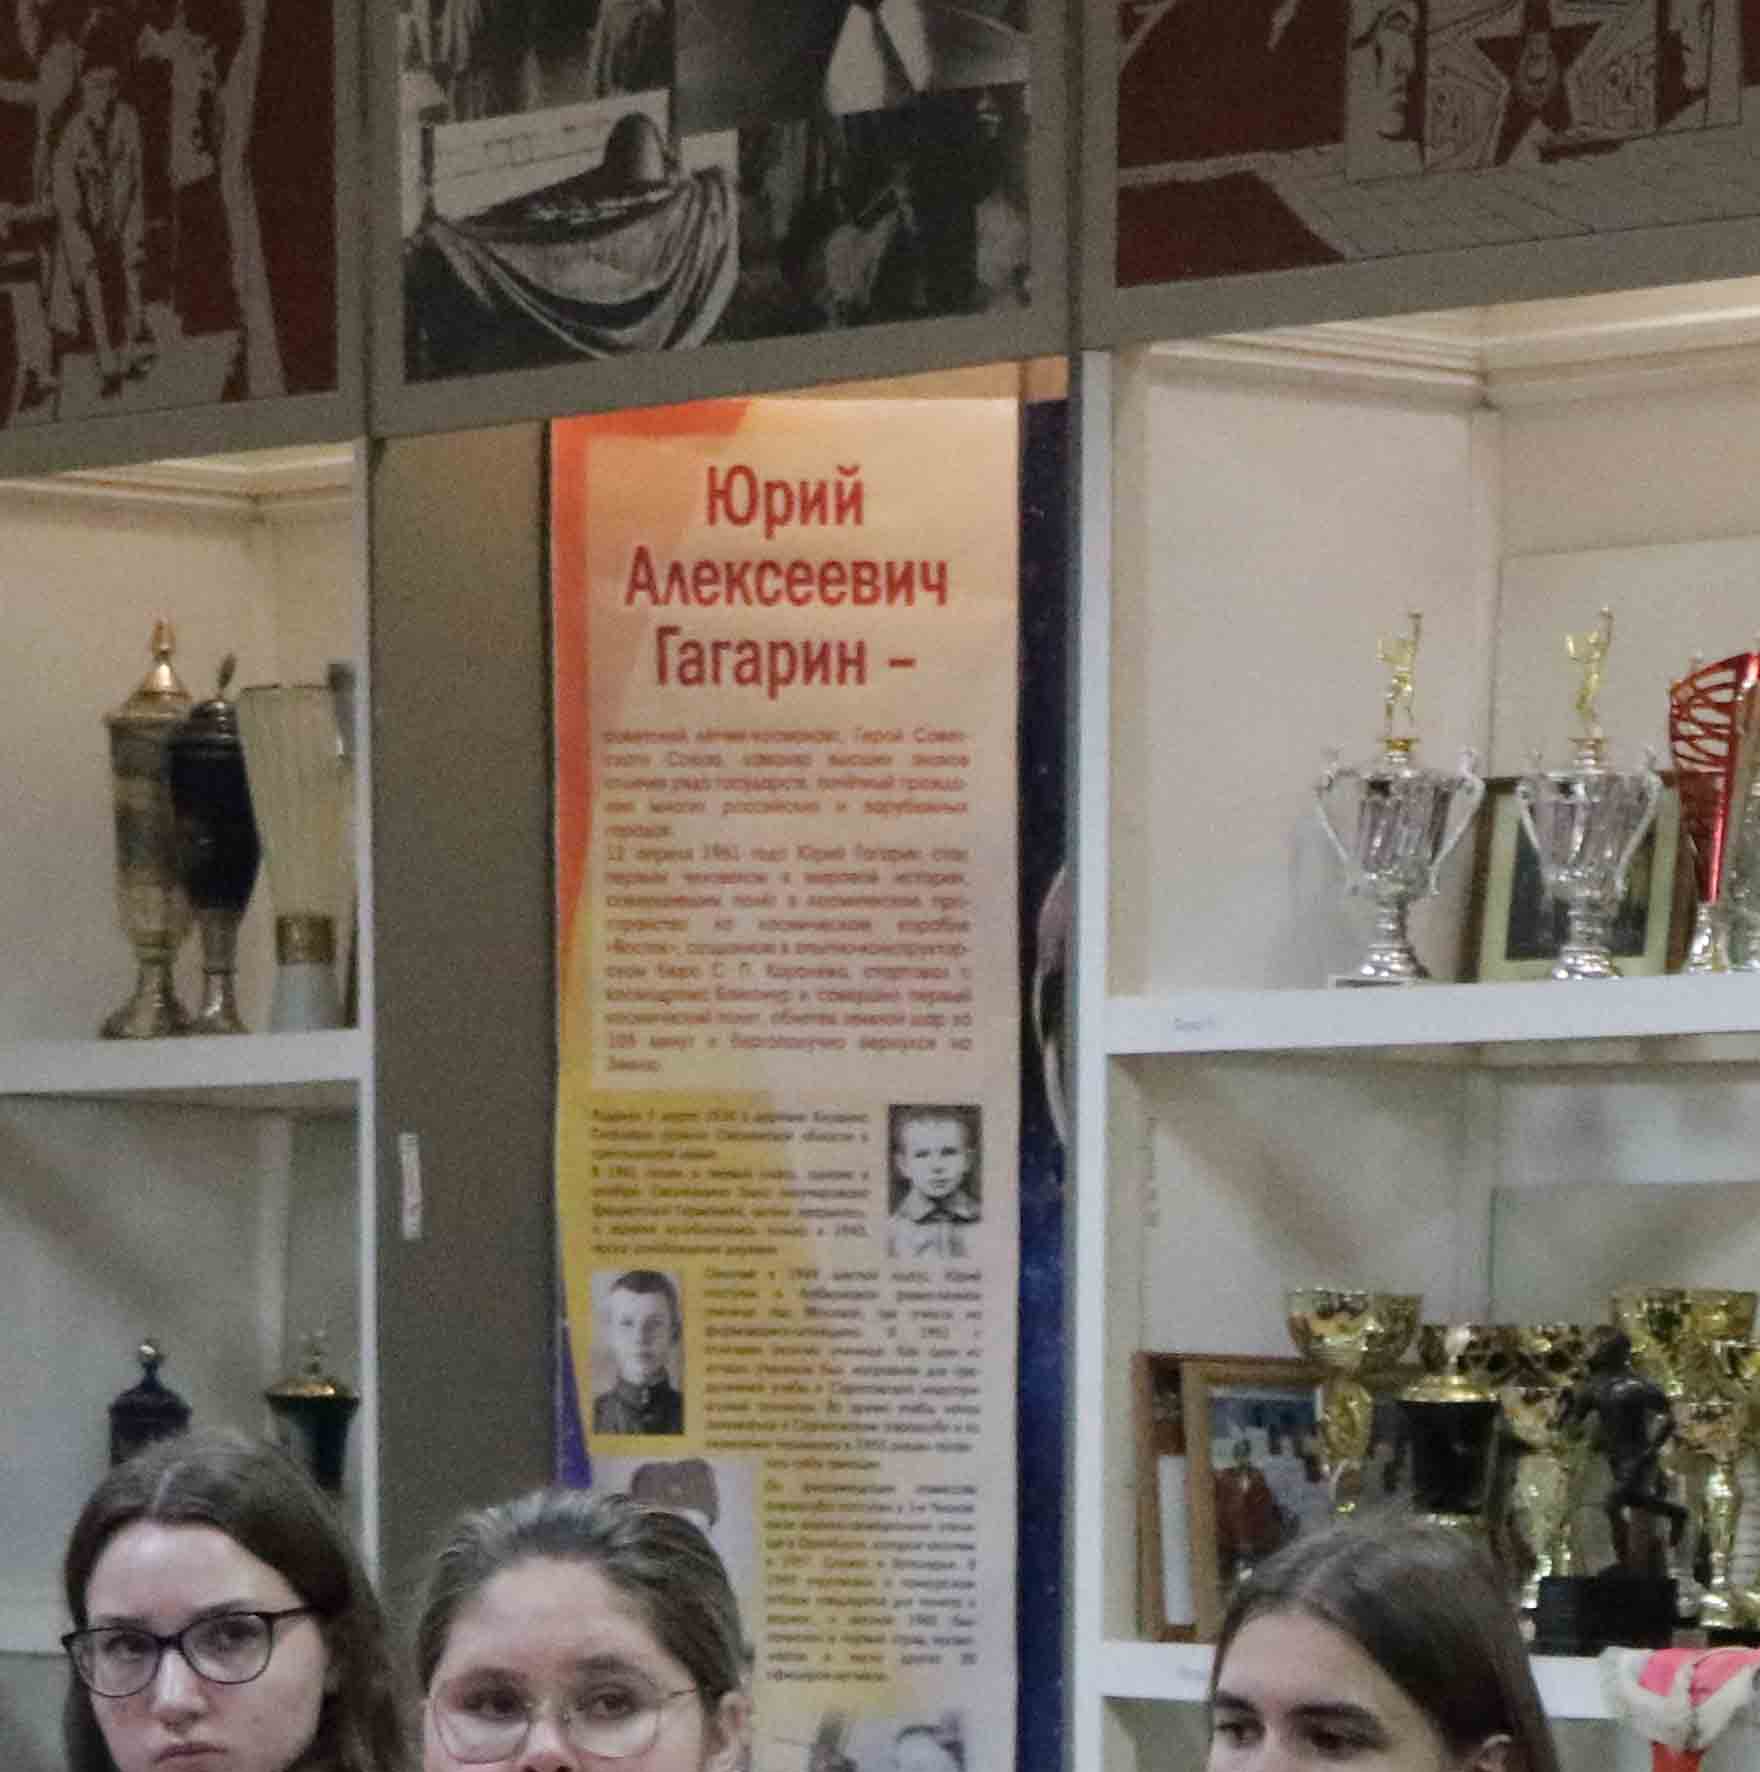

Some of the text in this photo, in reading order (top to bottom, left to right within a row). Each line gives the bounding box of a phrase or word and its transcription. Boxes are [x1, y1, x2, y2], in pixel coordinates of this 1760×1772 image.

[706, 464, 865, 540] Юрий
[624, 545, 949, 607] Алексеевич
[655, 625, 867, 700] Гагарин
